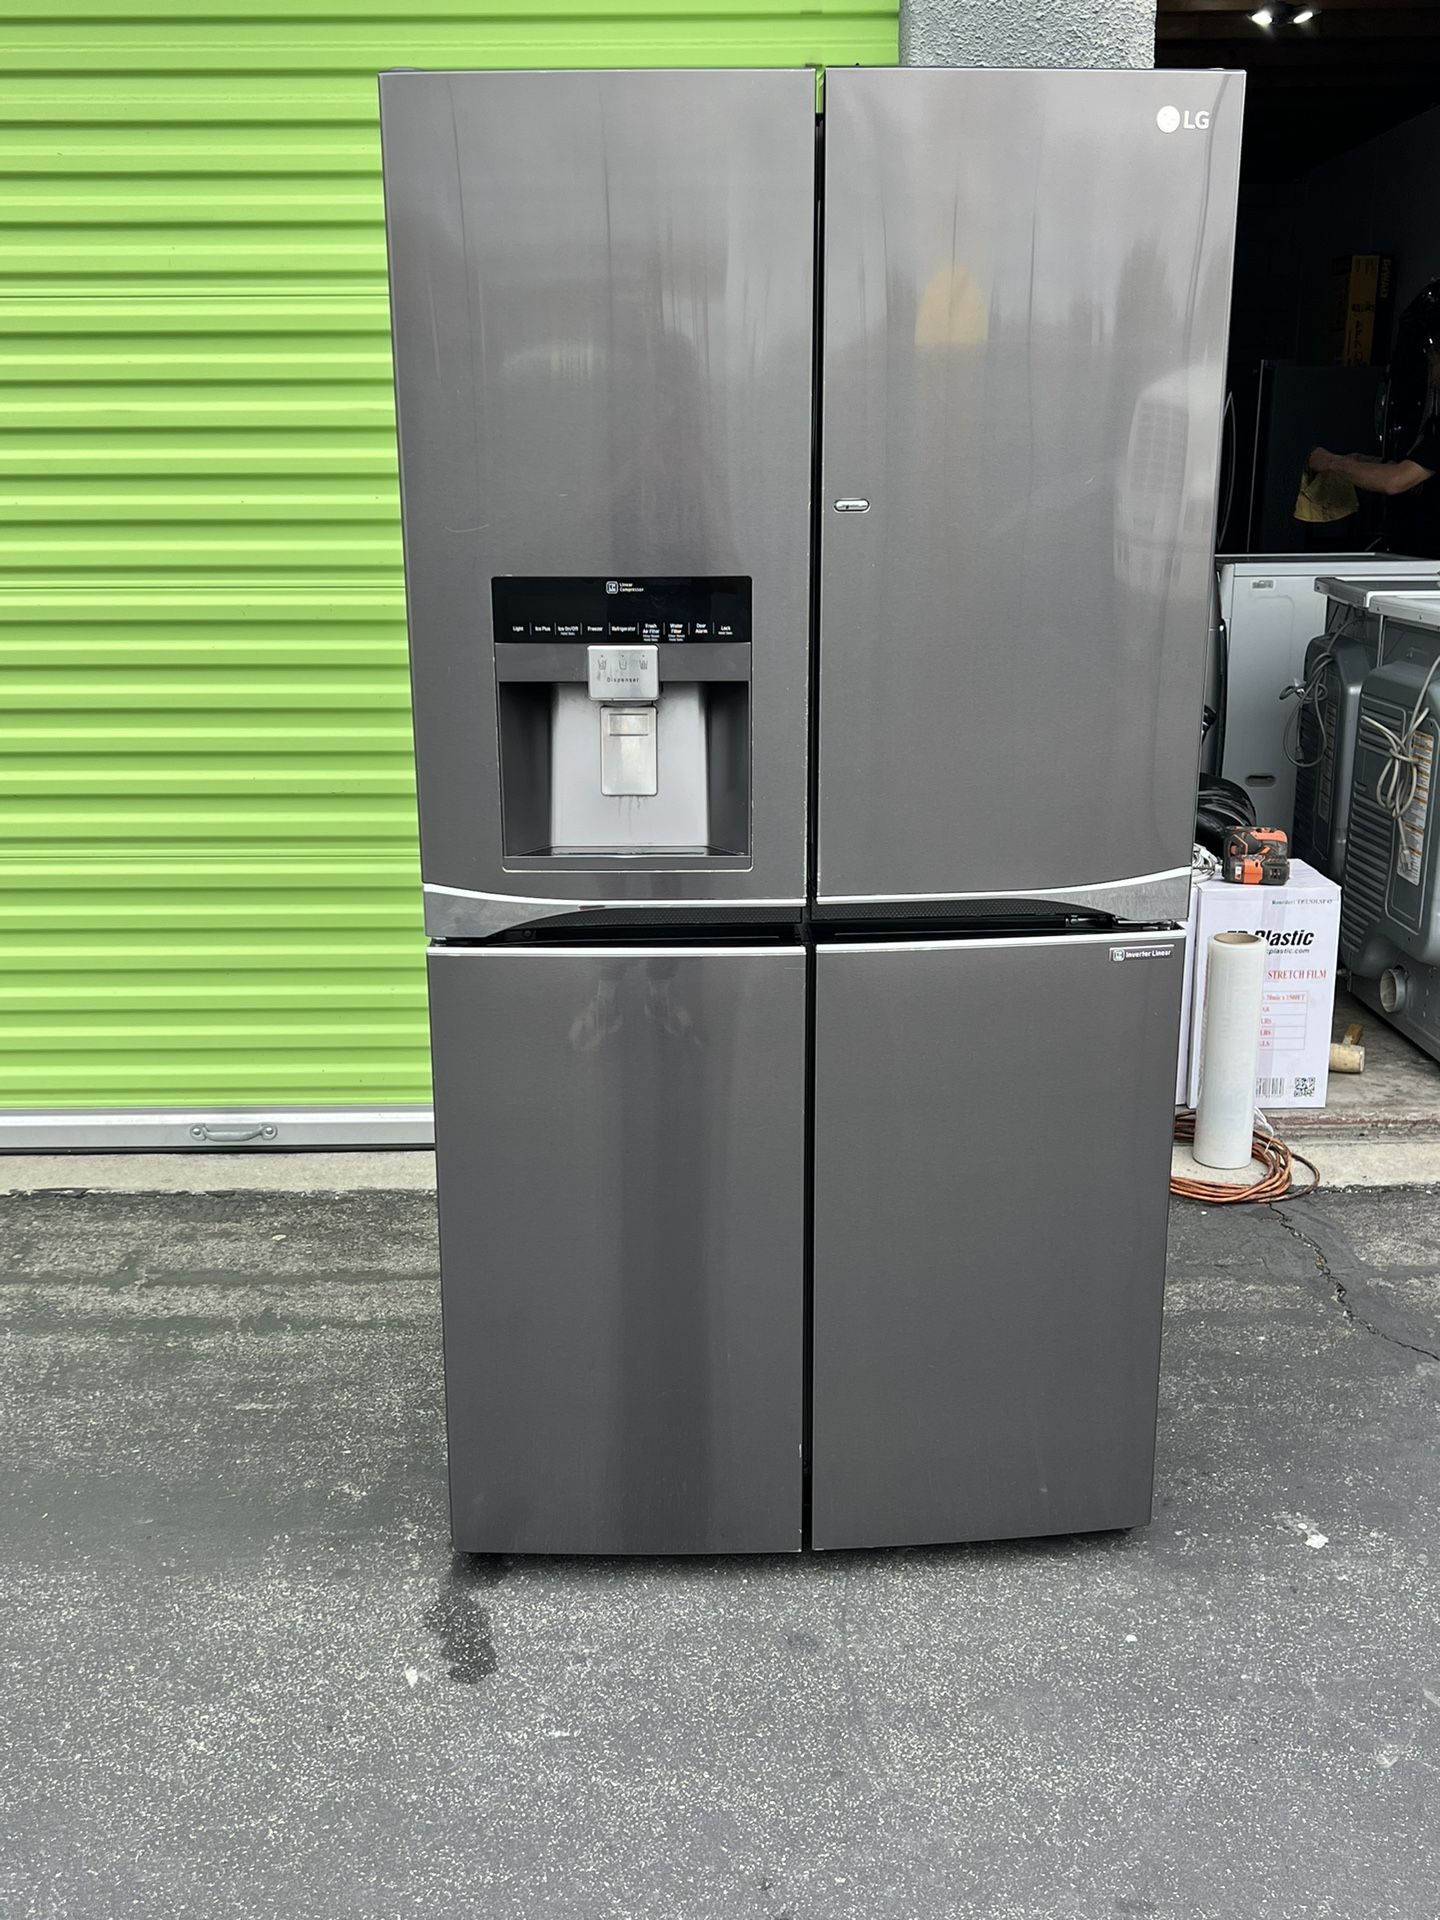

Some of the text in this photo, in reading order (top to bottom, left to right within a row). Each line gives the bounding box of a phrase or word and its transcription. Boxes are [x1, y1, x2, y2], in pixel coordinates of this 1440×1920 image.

[1183, 110, 1210, 129] LG
[512, 625, 524, 633] Light
[611, 625, 636, 633] Refrigerator
[606, 676, 640, 684] Dispenser
[1125, 949, 1171, 958] Inverter Linear
[1267, 969, 1327, 980] STRETCH FILM
